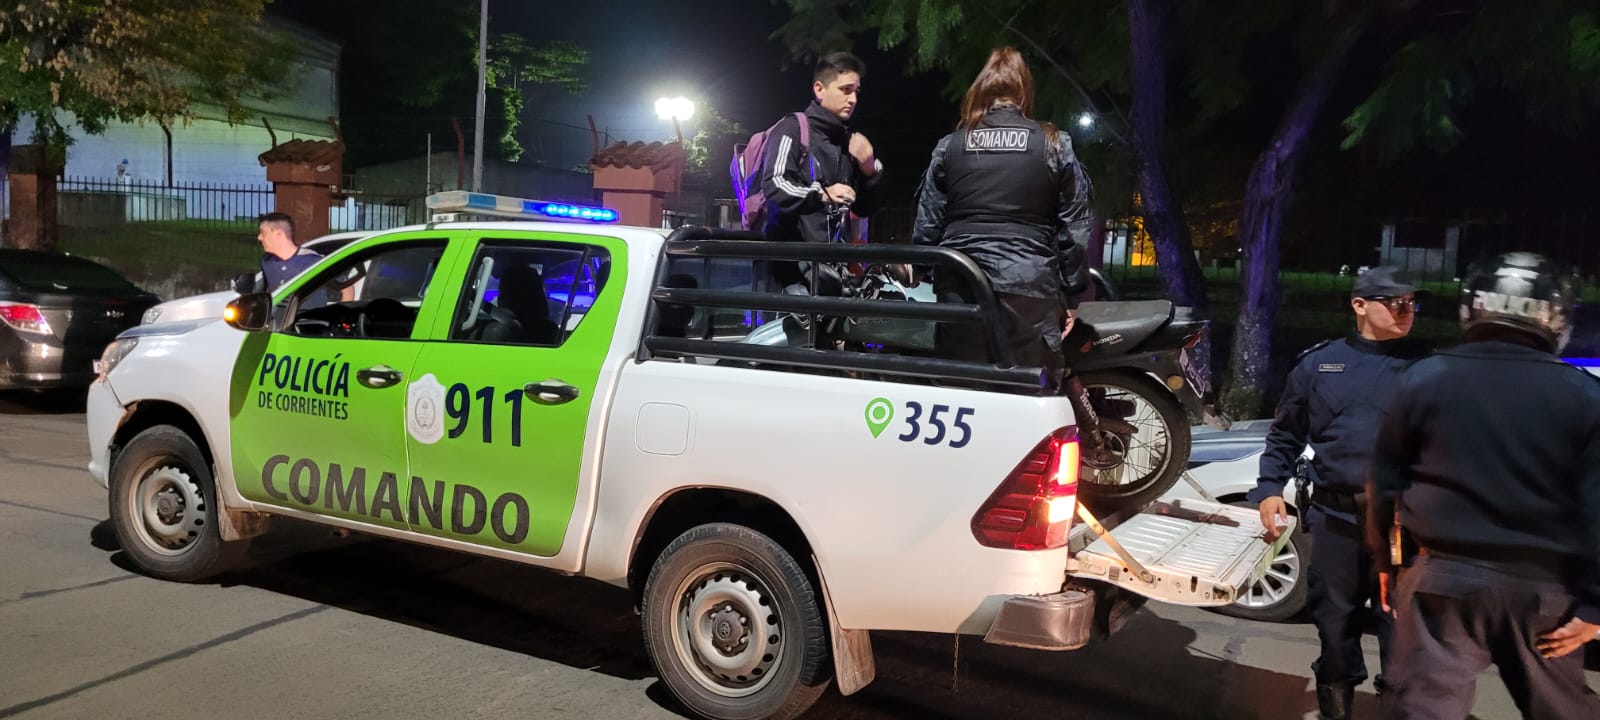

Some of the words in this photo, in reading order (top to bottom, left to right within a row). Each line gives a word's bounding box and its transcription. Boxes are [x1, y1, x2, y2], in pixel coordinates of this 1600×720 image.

[967, 130, 1027, 148] COMANDO
[259, 353, 350, 398] POLICÍA
[258, 390, 273, 408] DE
[275, 394, 349, 421] CORRIENTES
[446, 382, 524, 448] 911
[898, 401, 975, 449] 355
[261, 454, 531, 545] COMANDO
